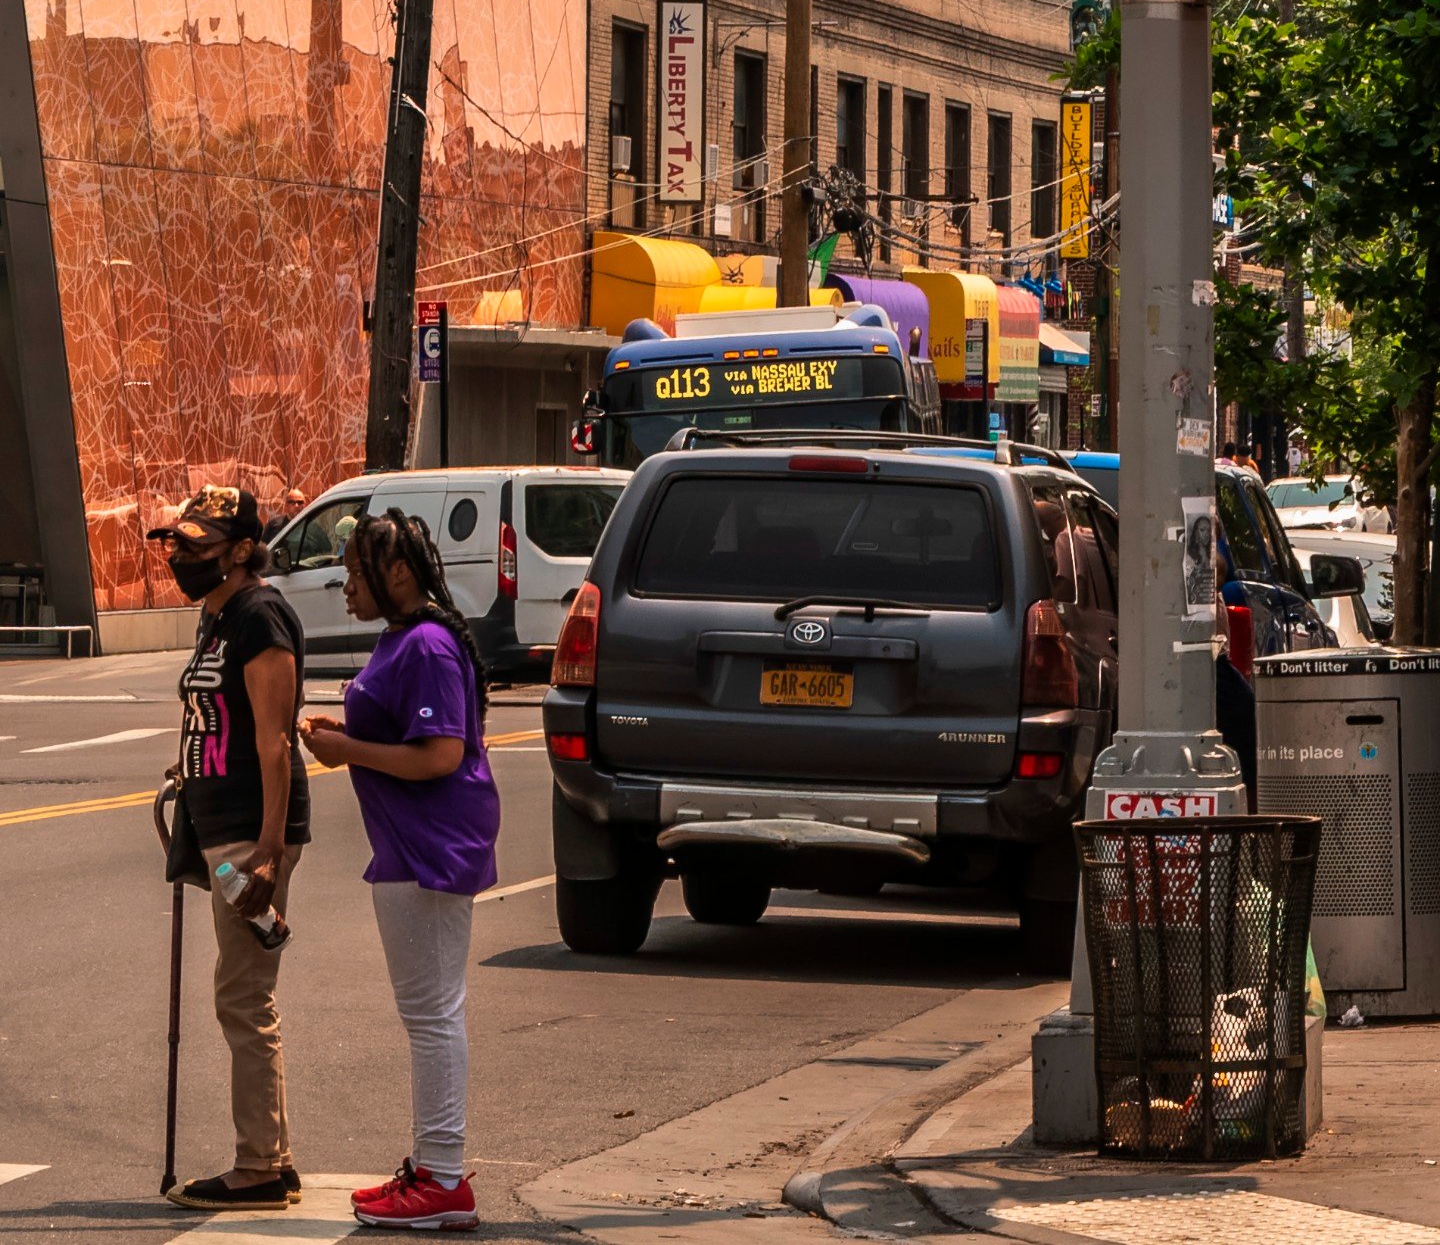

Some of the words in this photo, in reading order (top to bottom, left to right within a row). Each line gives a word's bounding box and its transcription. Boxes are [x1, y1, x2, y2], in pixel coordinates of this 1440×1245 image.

[667, 36, 695, 136] LIBERTY
[667, 141, 693, 194] TAX
[751, 361, 806, 380] NASSAU
[655, 367, 711, 399] Q113
[758, 376, 811, 393] BREWER
[815, 374, 833, 390] BL
[1280, 660, 1311, 674] Don't
[1314, 661, 1349, 674] litter
[1389, 658, 1425, 671] Don't
[807, 674, 845, 697] 6605
[611, 715, 649, 727] TOYOTA
[937, 731, 1007, 744] 4RUNNER
[1266, 746, 1277, 760] in
[1279, 746, 1295, 760] its
[1299, 745, 1345, 763] place
[1110, 795, 1211, 819] CASH
